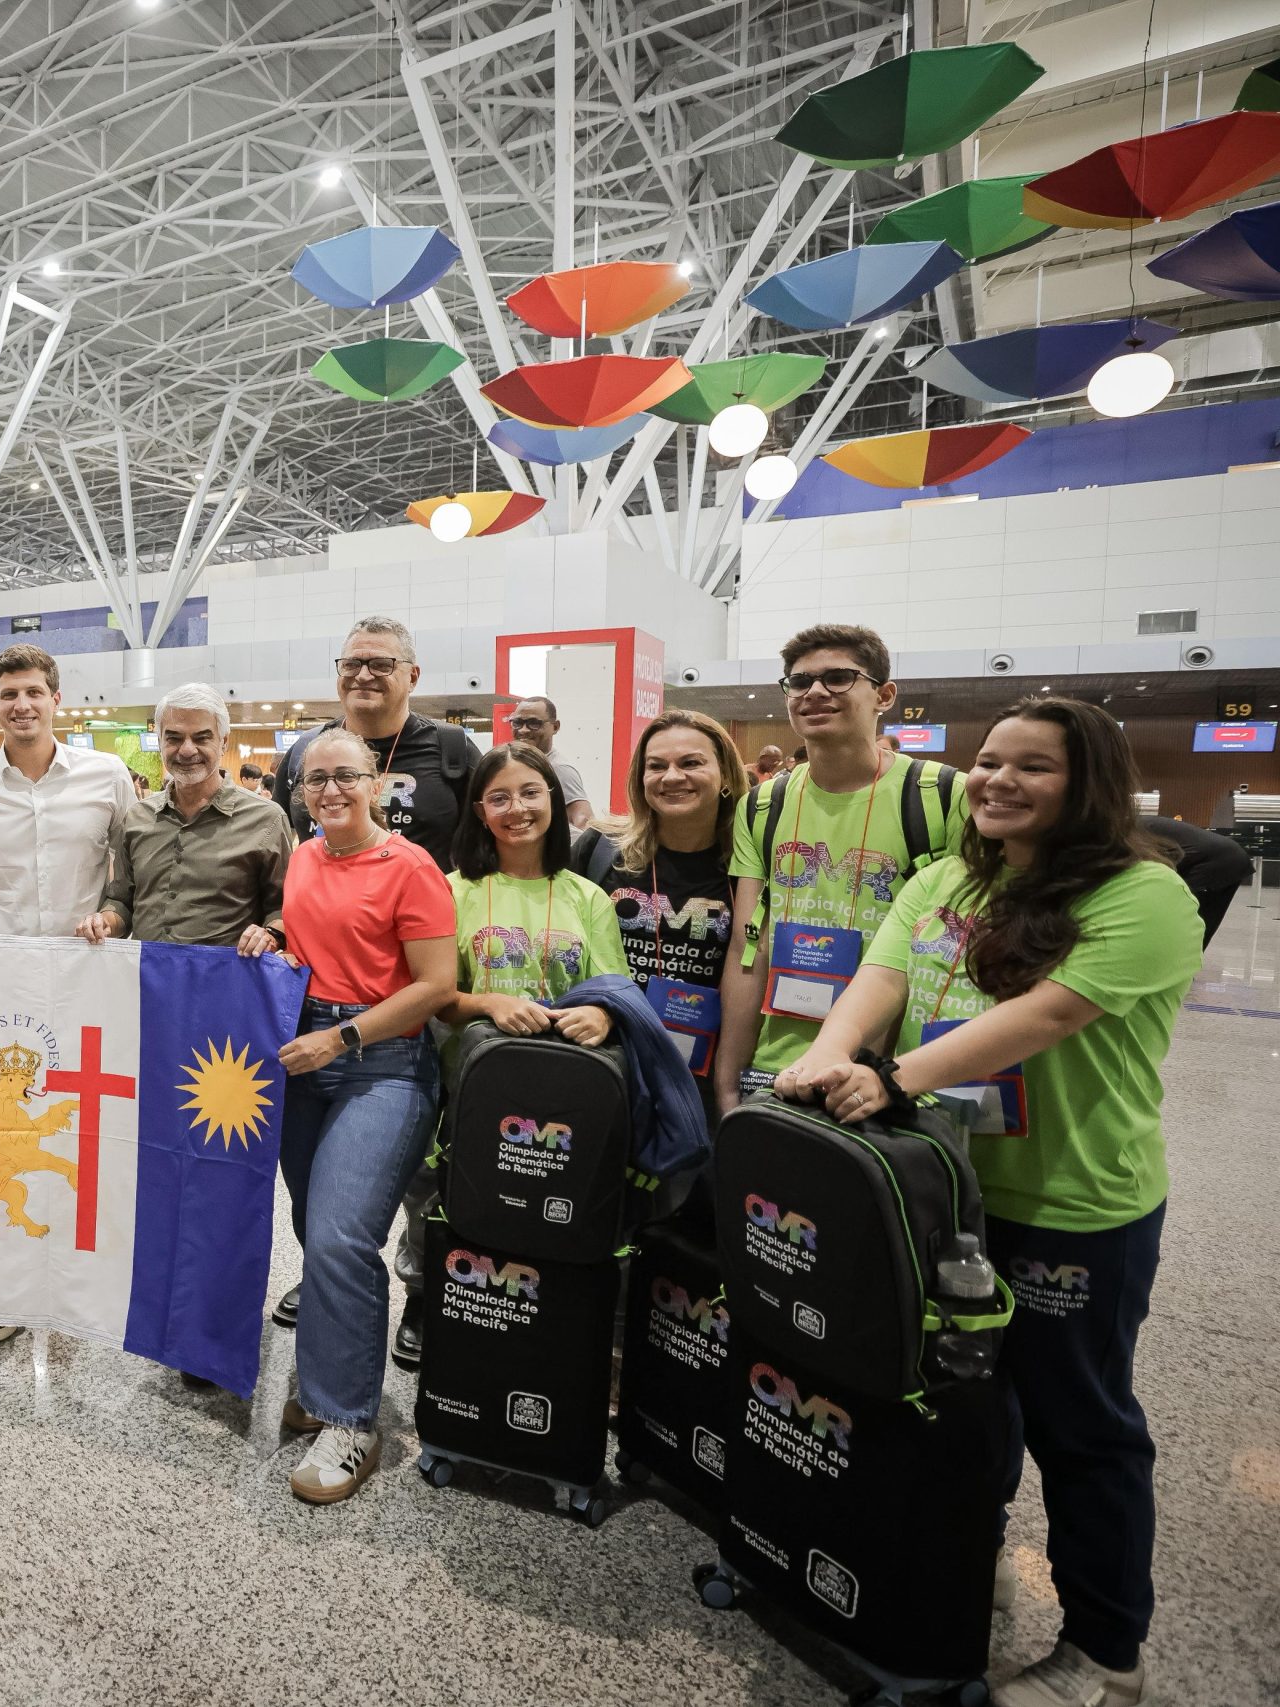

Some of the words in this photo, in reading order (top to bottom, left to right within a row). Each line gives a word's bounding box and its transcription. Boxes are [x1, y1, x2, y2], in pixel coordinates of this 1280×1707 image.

[284, 719, 296, 729] 54
[904, 708, 924, 719] 57
[1226, 704, 1252, 716] 59
[392, 811, 412, 823] de
[774, 841, 899, 902] OMR
[610, 887, 731, 942] OMR
[472, 926, 583, 975] OMR
[793, 933, 835, 950] OMR
[14, 1014, 34, 1027] ET
[36, 1023, 59, 1070] FIDES
[500, 1115, 572, 1150] OMR
[498, 1152, 564, 1170] Matemática
[500, 1142, 554, 1159] Olimpíada
[556, 1153, 570, 1162] de
[498, 1162, 511, 1171] do
[513, 1164, 547, 1178] Recife
[745, 1193, 817, 1250] OMR
[746, 1222, 798, 1256] Olimpíada
[801, 1250, 816, 1263] de
[746, 1232, 811, 1272] Matemática
[746, 1245, 758, 1257] do
[761, 1251, 793, 1275] Recife
[446, 1249, 541, 1300] OMR
[1010, 1257, 1090, 1291] OMR
[444, 1293, 530, 1325] Matemática
[445, 1282, 516, 1309] Olimpíada
[520, 1301, 538, 1314] de
[652, 1276, 730, 1343] OMR
[442, 1307, 459, 1319] do
[463, 1311, 508, 1332] Recife
[650, 1309, 708, 1348] Olimpíada
[711, 1340, 728, 1358] de
[648, 1334, 661, 1347] do
[664, 1342, 700, 1370] Recife
[649, 1320, 720, 1367] Matemática
[425, 1390, 467, 1410] Secretaria
[469, 1400, 479, 1412] de
[438, 1403, 479, 1420] Educação
[749, 1362, 853, 1451] OMR
[513, 1414, 544, 1427] RECIFE
[748, 1399, 823, 1453] Olimpíada
[828, 1449, 849, 1468] de
[698, 1450, 725, 1473] RECIFE
[744, 1427, 761, 1444] do
[764, 1438, 812, 1477] Recife
[746, 1410, 839, 1478] Matemática
[730, 1515, 776, 1552] Secretaria
[777, 1547, 790, 1561] de
[744, 1533, 789, 1570] Educação
[814, 1577, 848, 1609] RECIFE
